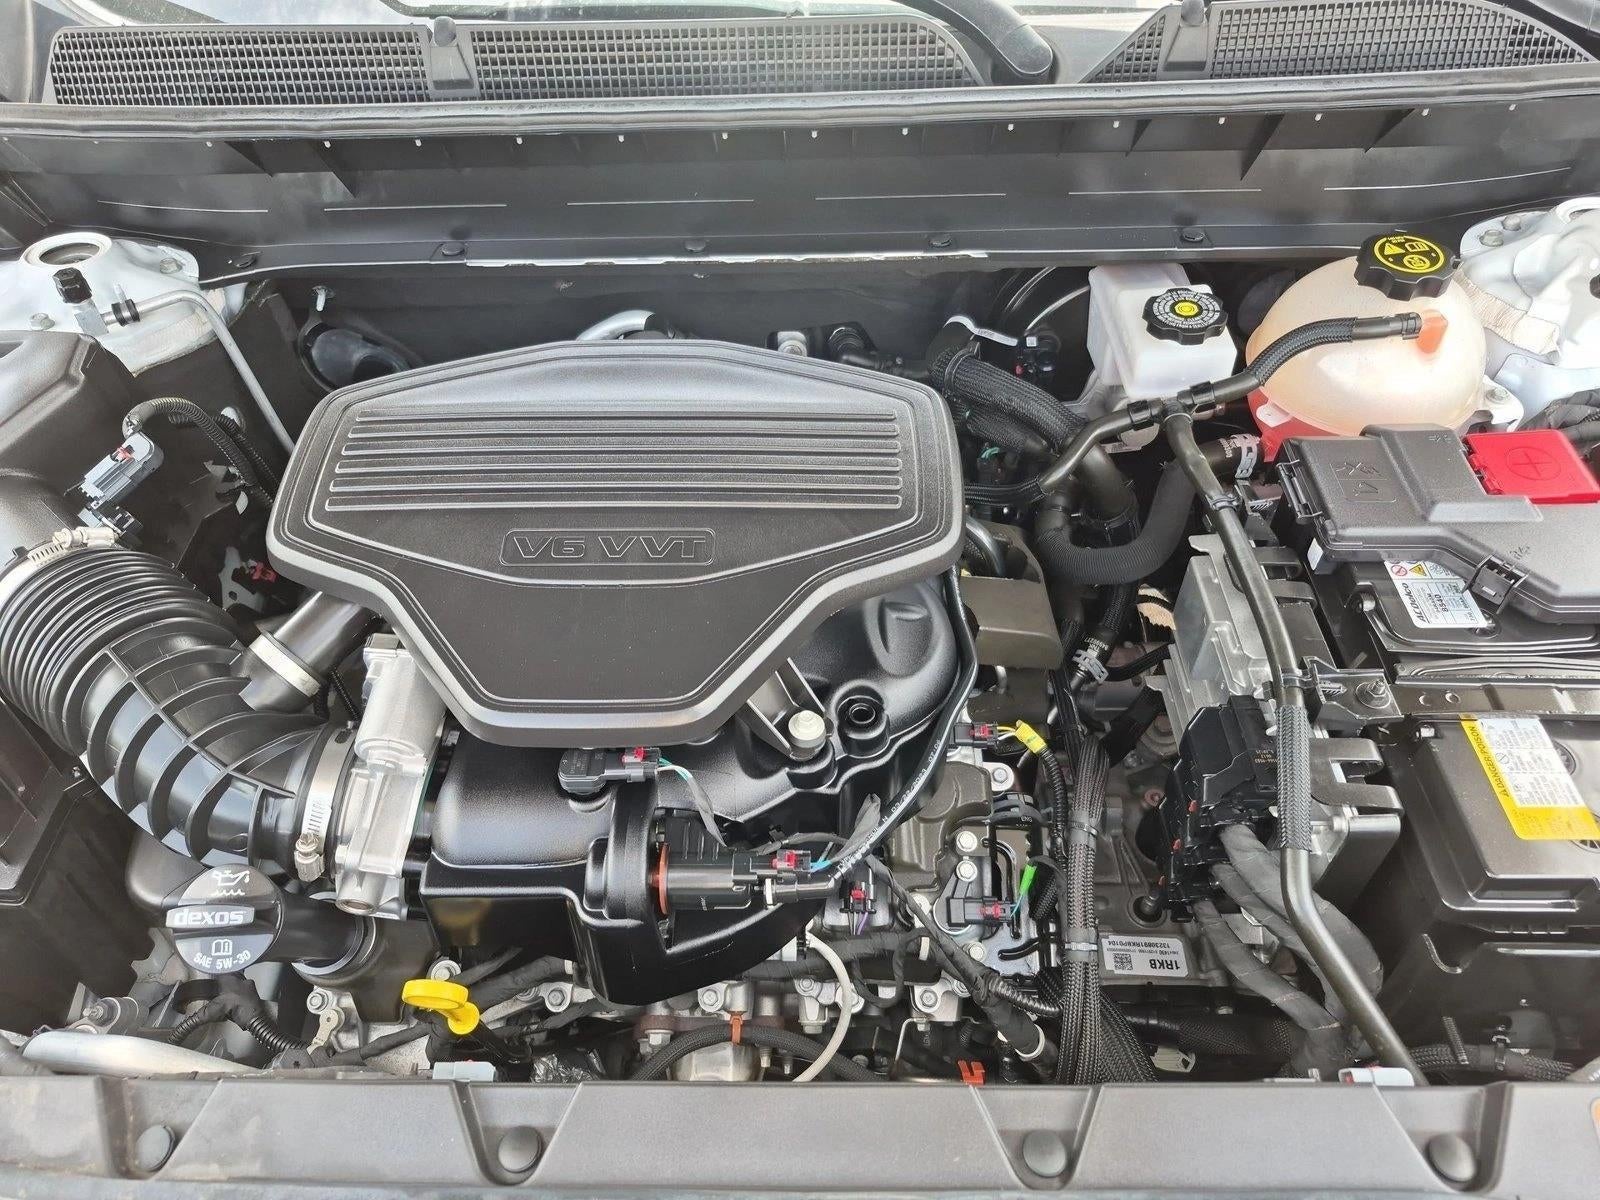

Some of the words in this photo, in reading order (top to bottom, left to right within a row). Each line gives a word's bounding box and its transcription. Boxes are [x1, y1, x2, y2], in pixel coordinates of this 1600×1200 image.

[513, 536, 586, 558] V6
[597, 536, 706, 558] VVT
[1401, 582, 1427, 623] ACDelco
[174, 908, 245, 926] dexos
[193, 952, 212, 969] SAE
[215, 949, 251, 970] 5W-30
[1149, 958, 1180, 970] 1RKB
